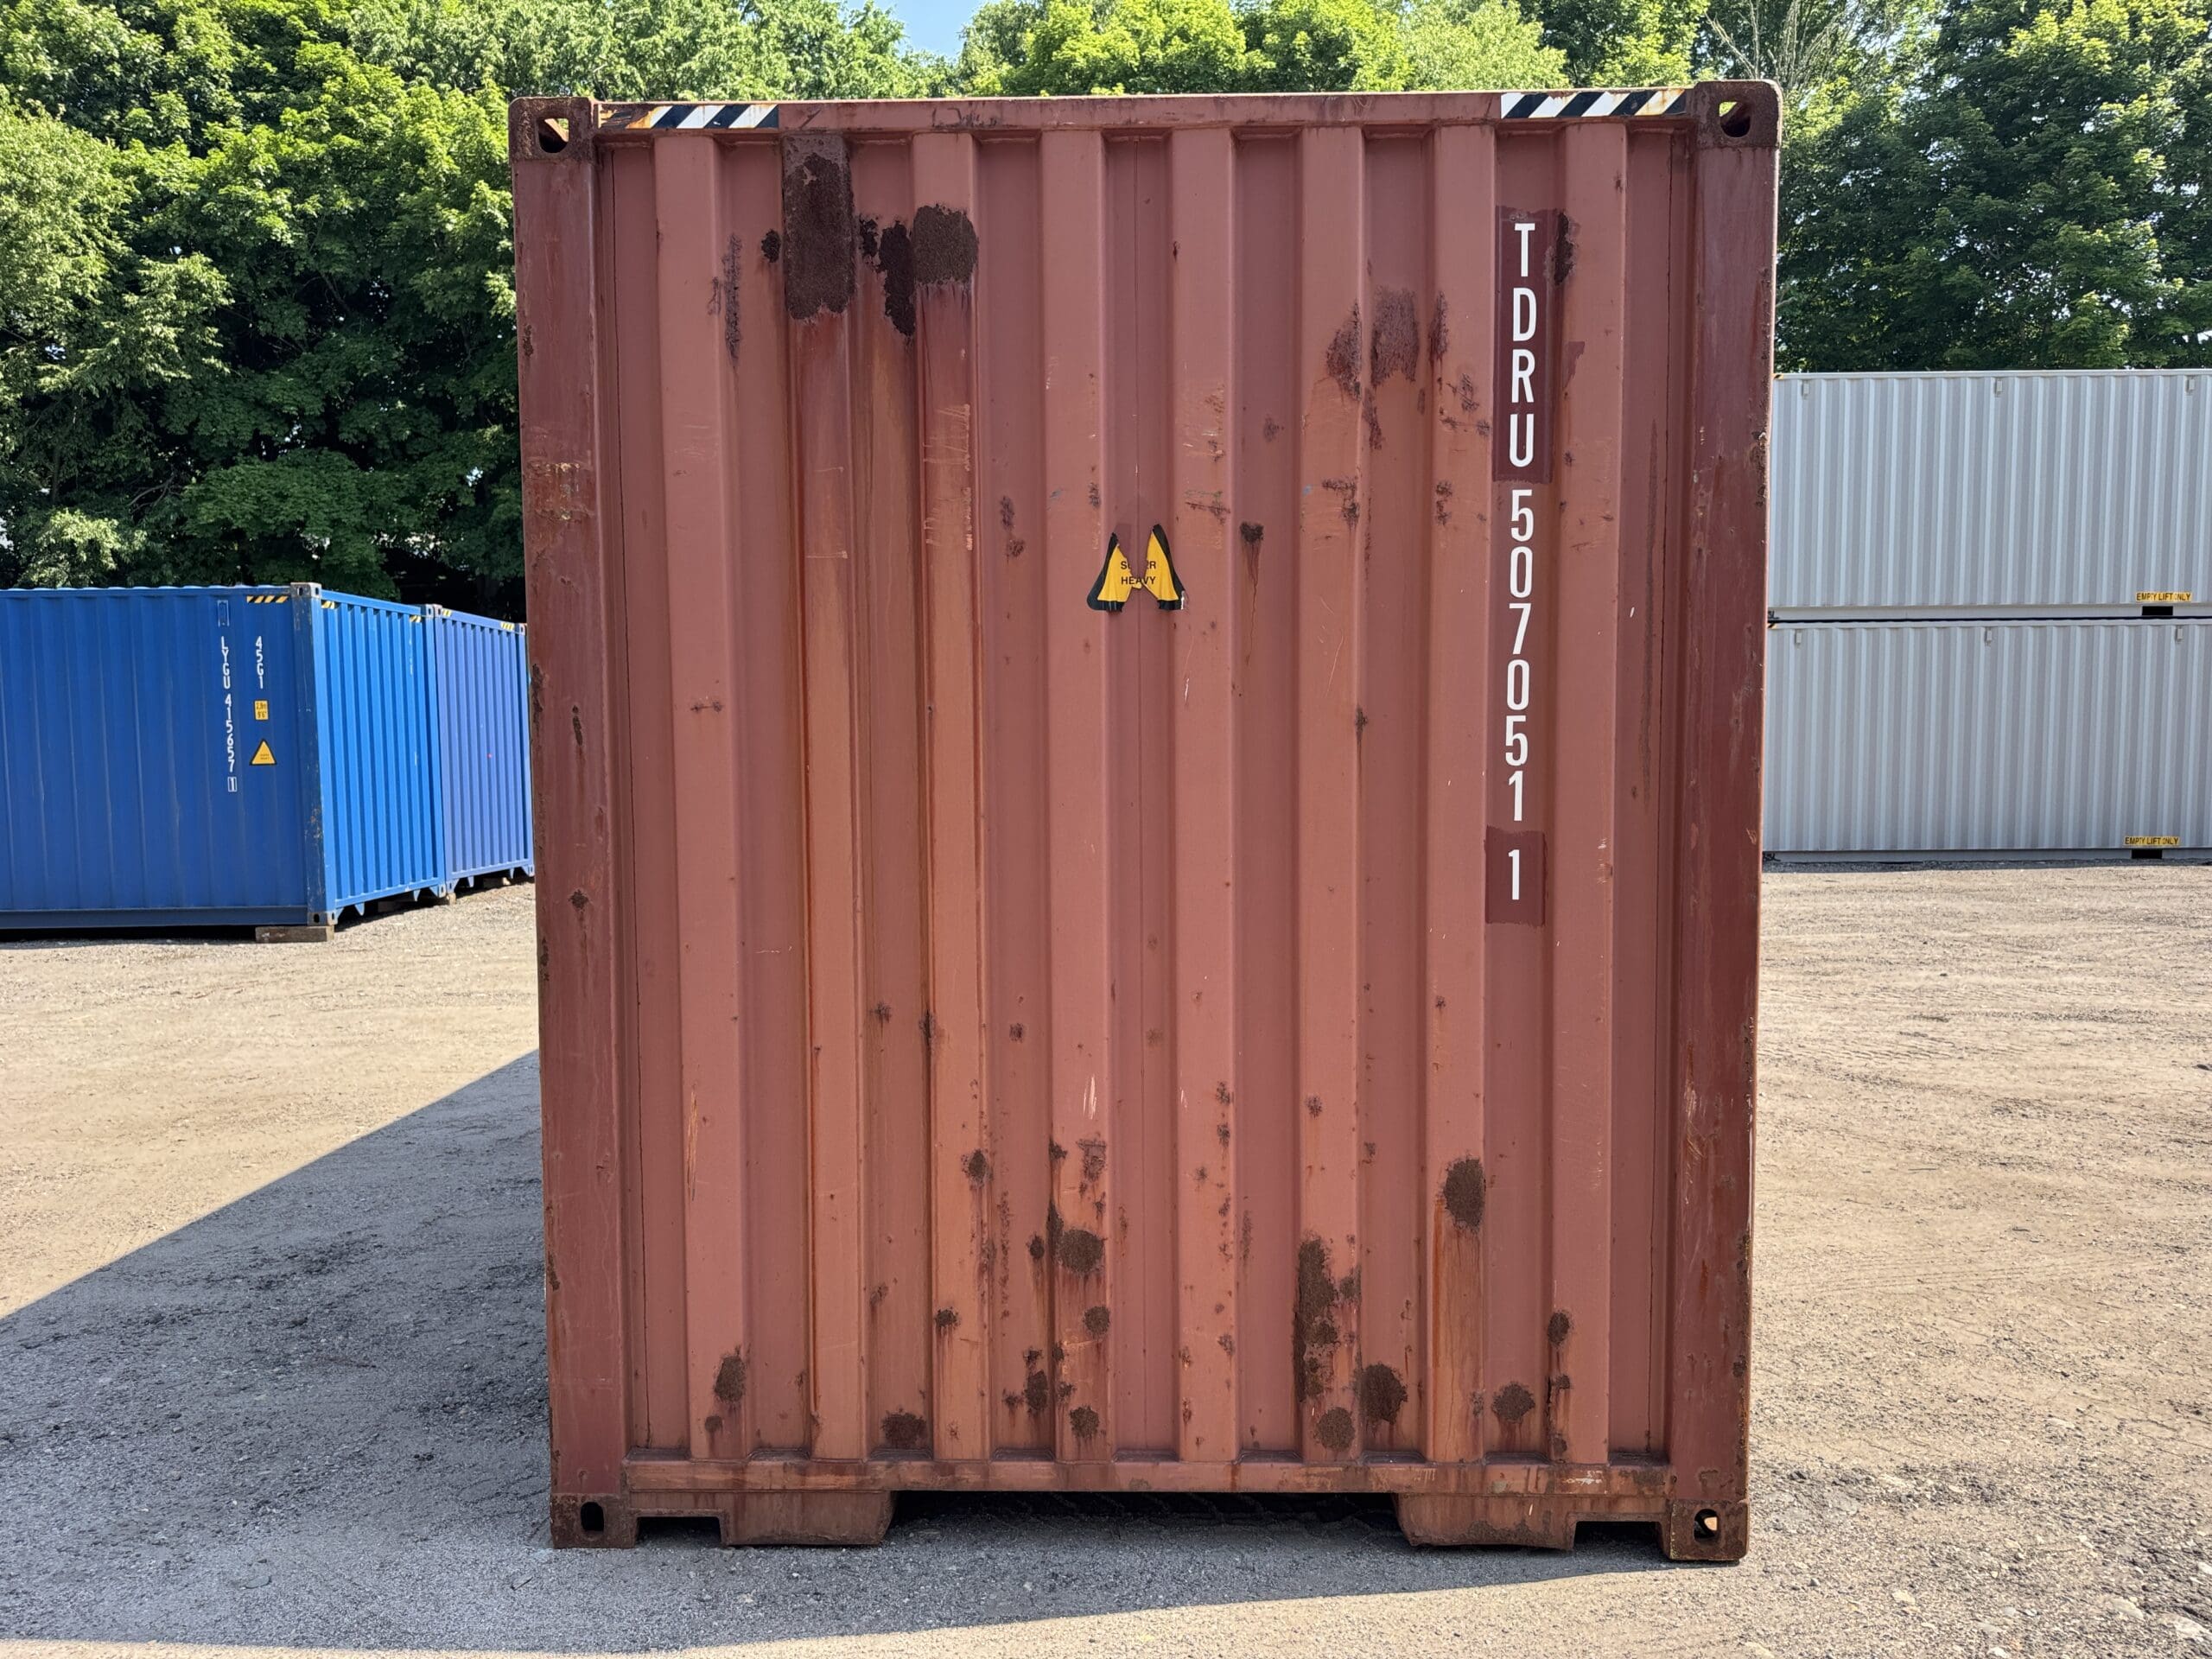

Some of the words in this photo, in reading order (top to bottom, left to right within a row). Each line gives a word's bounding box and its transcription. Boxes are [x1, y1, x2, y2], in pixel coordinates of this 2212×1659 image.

[1509, 222, 1538, 467] TDRU
[1121, 575, 1156, 585] HEAVY
[2136, 593, 2157, 601] EMPTY
[2158, 593, 2174, 601] LIFT
[220, 635, 232, 690] LYGU
[255, 635, 264, 690] 45G1
[1504, 489, 1535, 822] 507051
[224, 693, 236, 772] 415657
[229, 778, 236, 791] 1
[2125, 836, 2145, 845] EMPTY
[2147, 836, 2162, 845] LIFT
[2162, 836, 2179, 845] ONLY
[1507, 849, 1521, 900] 1
